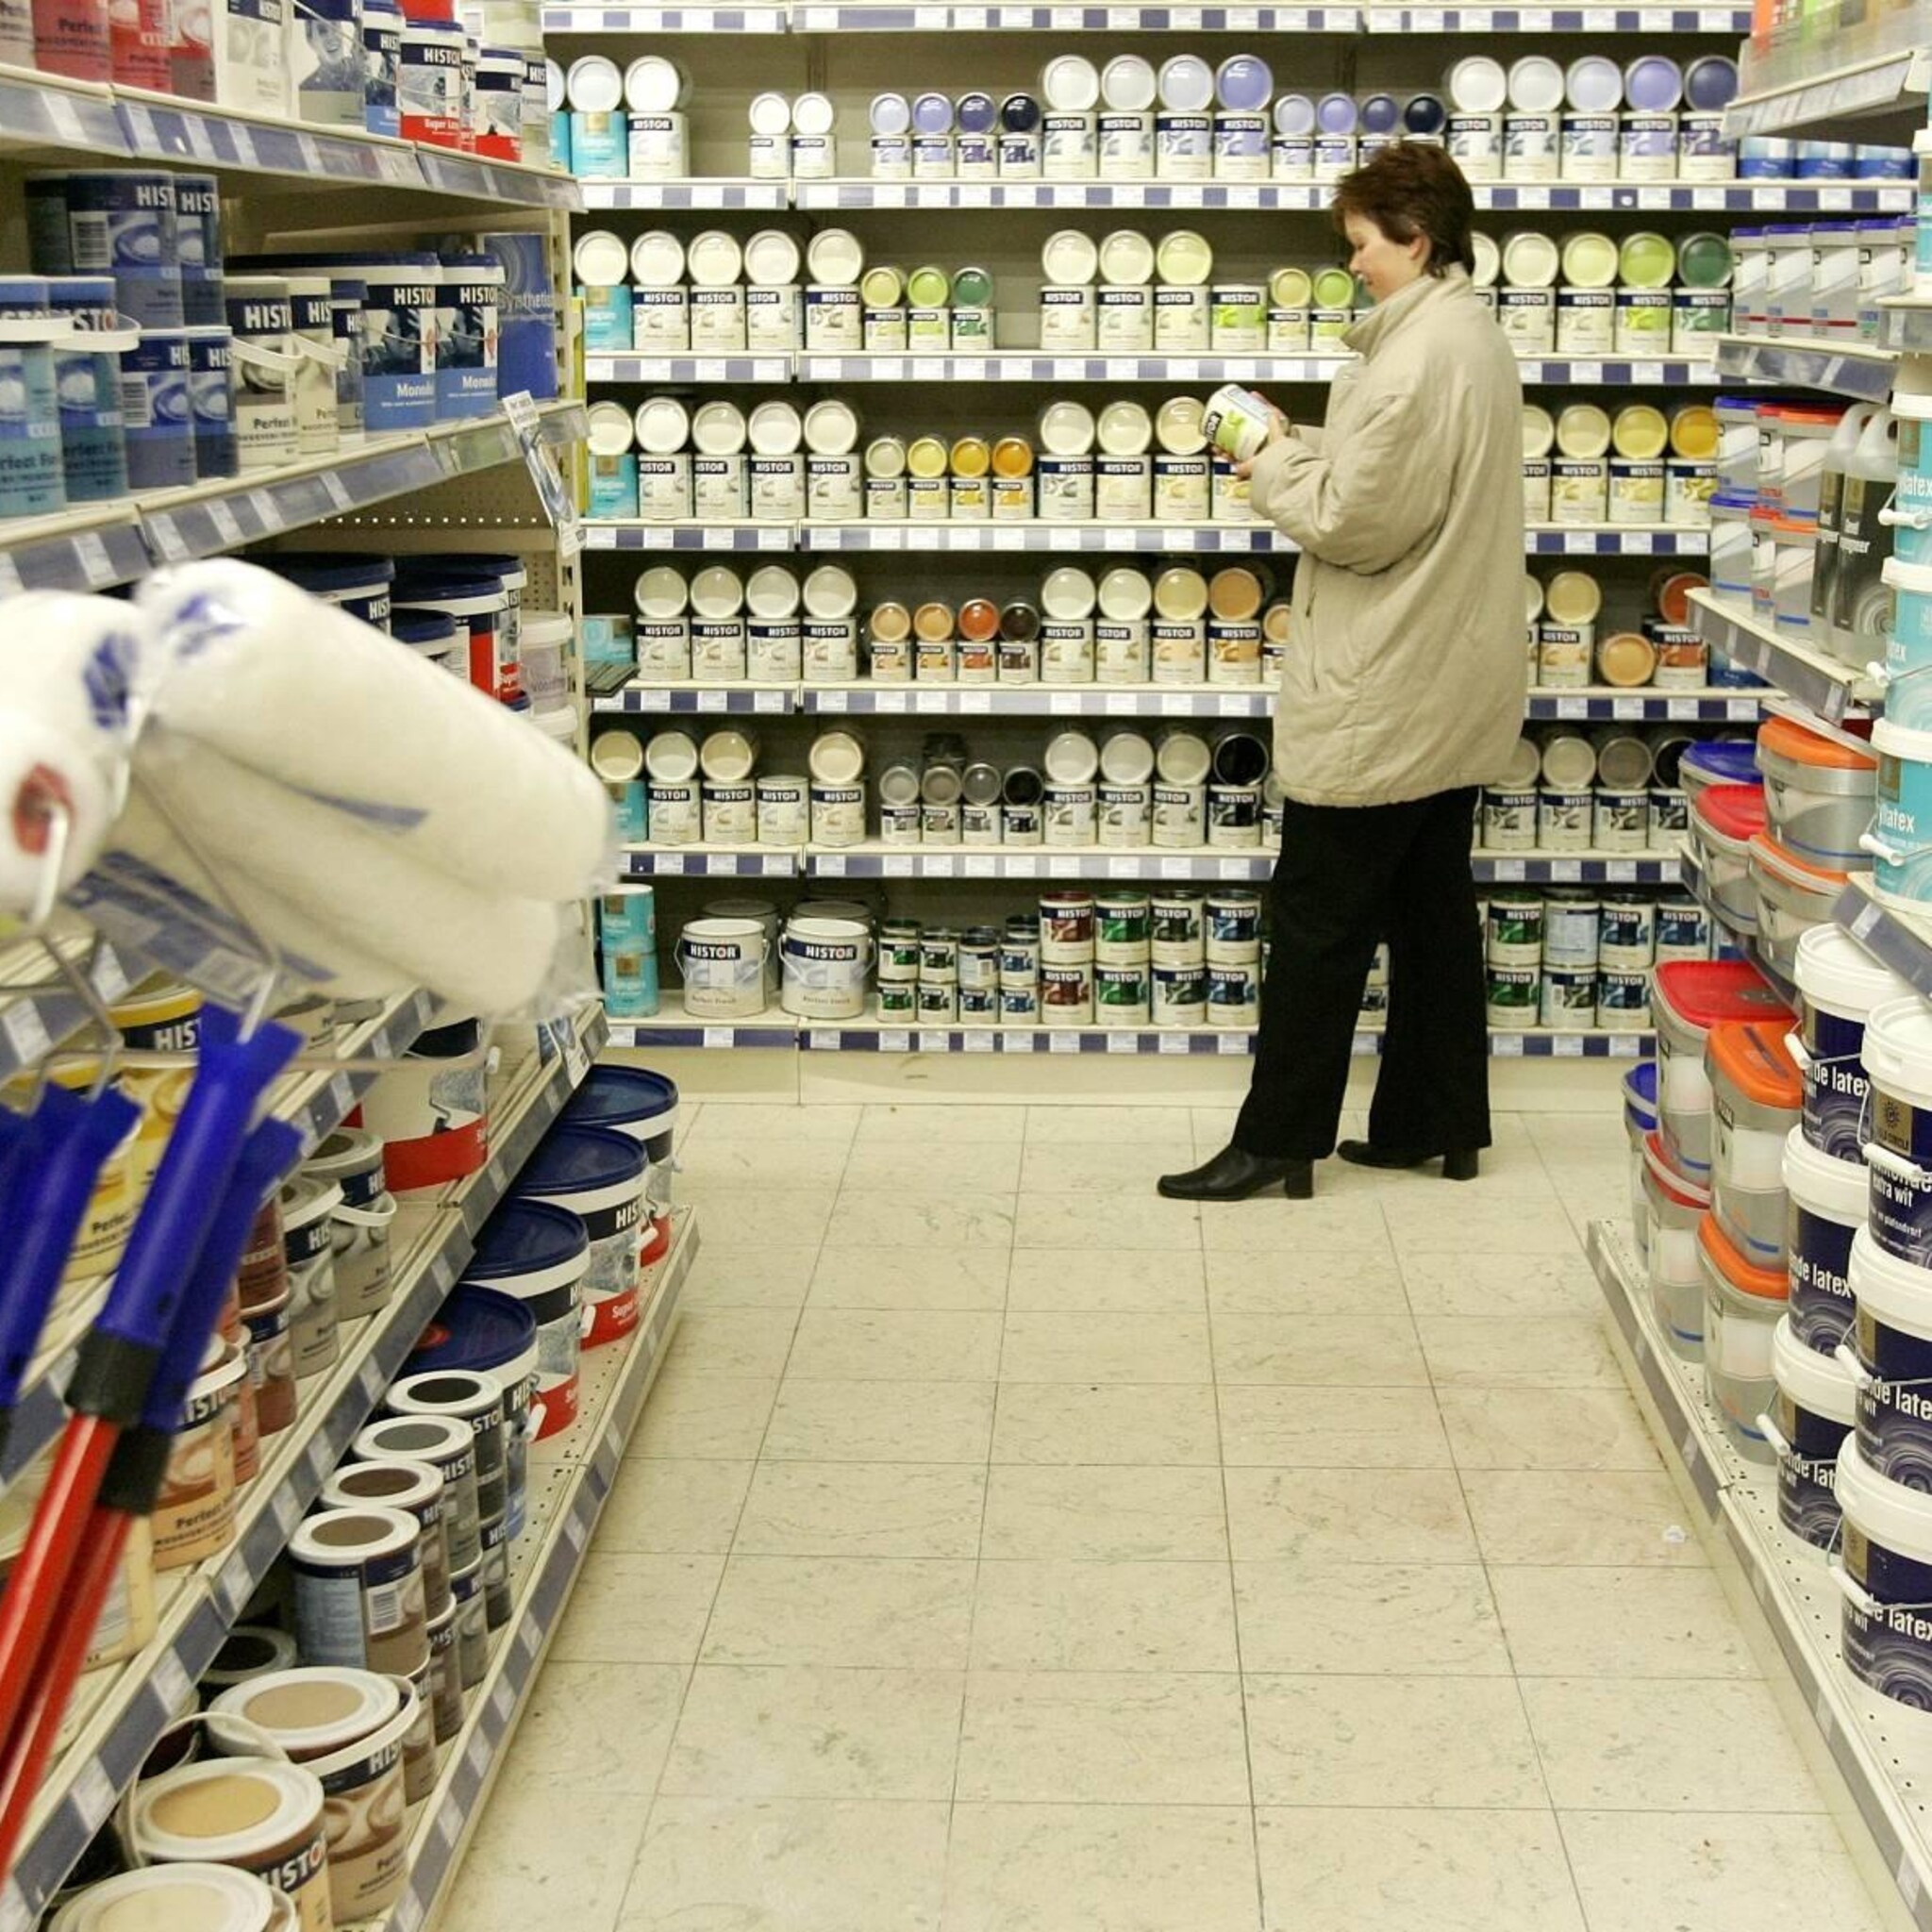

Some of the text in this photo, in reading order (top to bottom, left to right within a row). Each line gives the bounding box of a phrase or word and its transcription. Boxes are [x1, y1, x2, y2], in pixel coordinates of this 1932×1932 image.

[425, 48, 461, 65] HISTO
[393, 288, 435, 305] HISTO
[459, 286, 497, 304] HISTO
[691, 944, 737, 958] HISTOR
[805, 946, 854, 959] HISTOR
[155, 1018, 201, 1051] HIS
[1894, 1186, 1913, 1208] wit
[1813, 1263, 1852, 1298] latex
